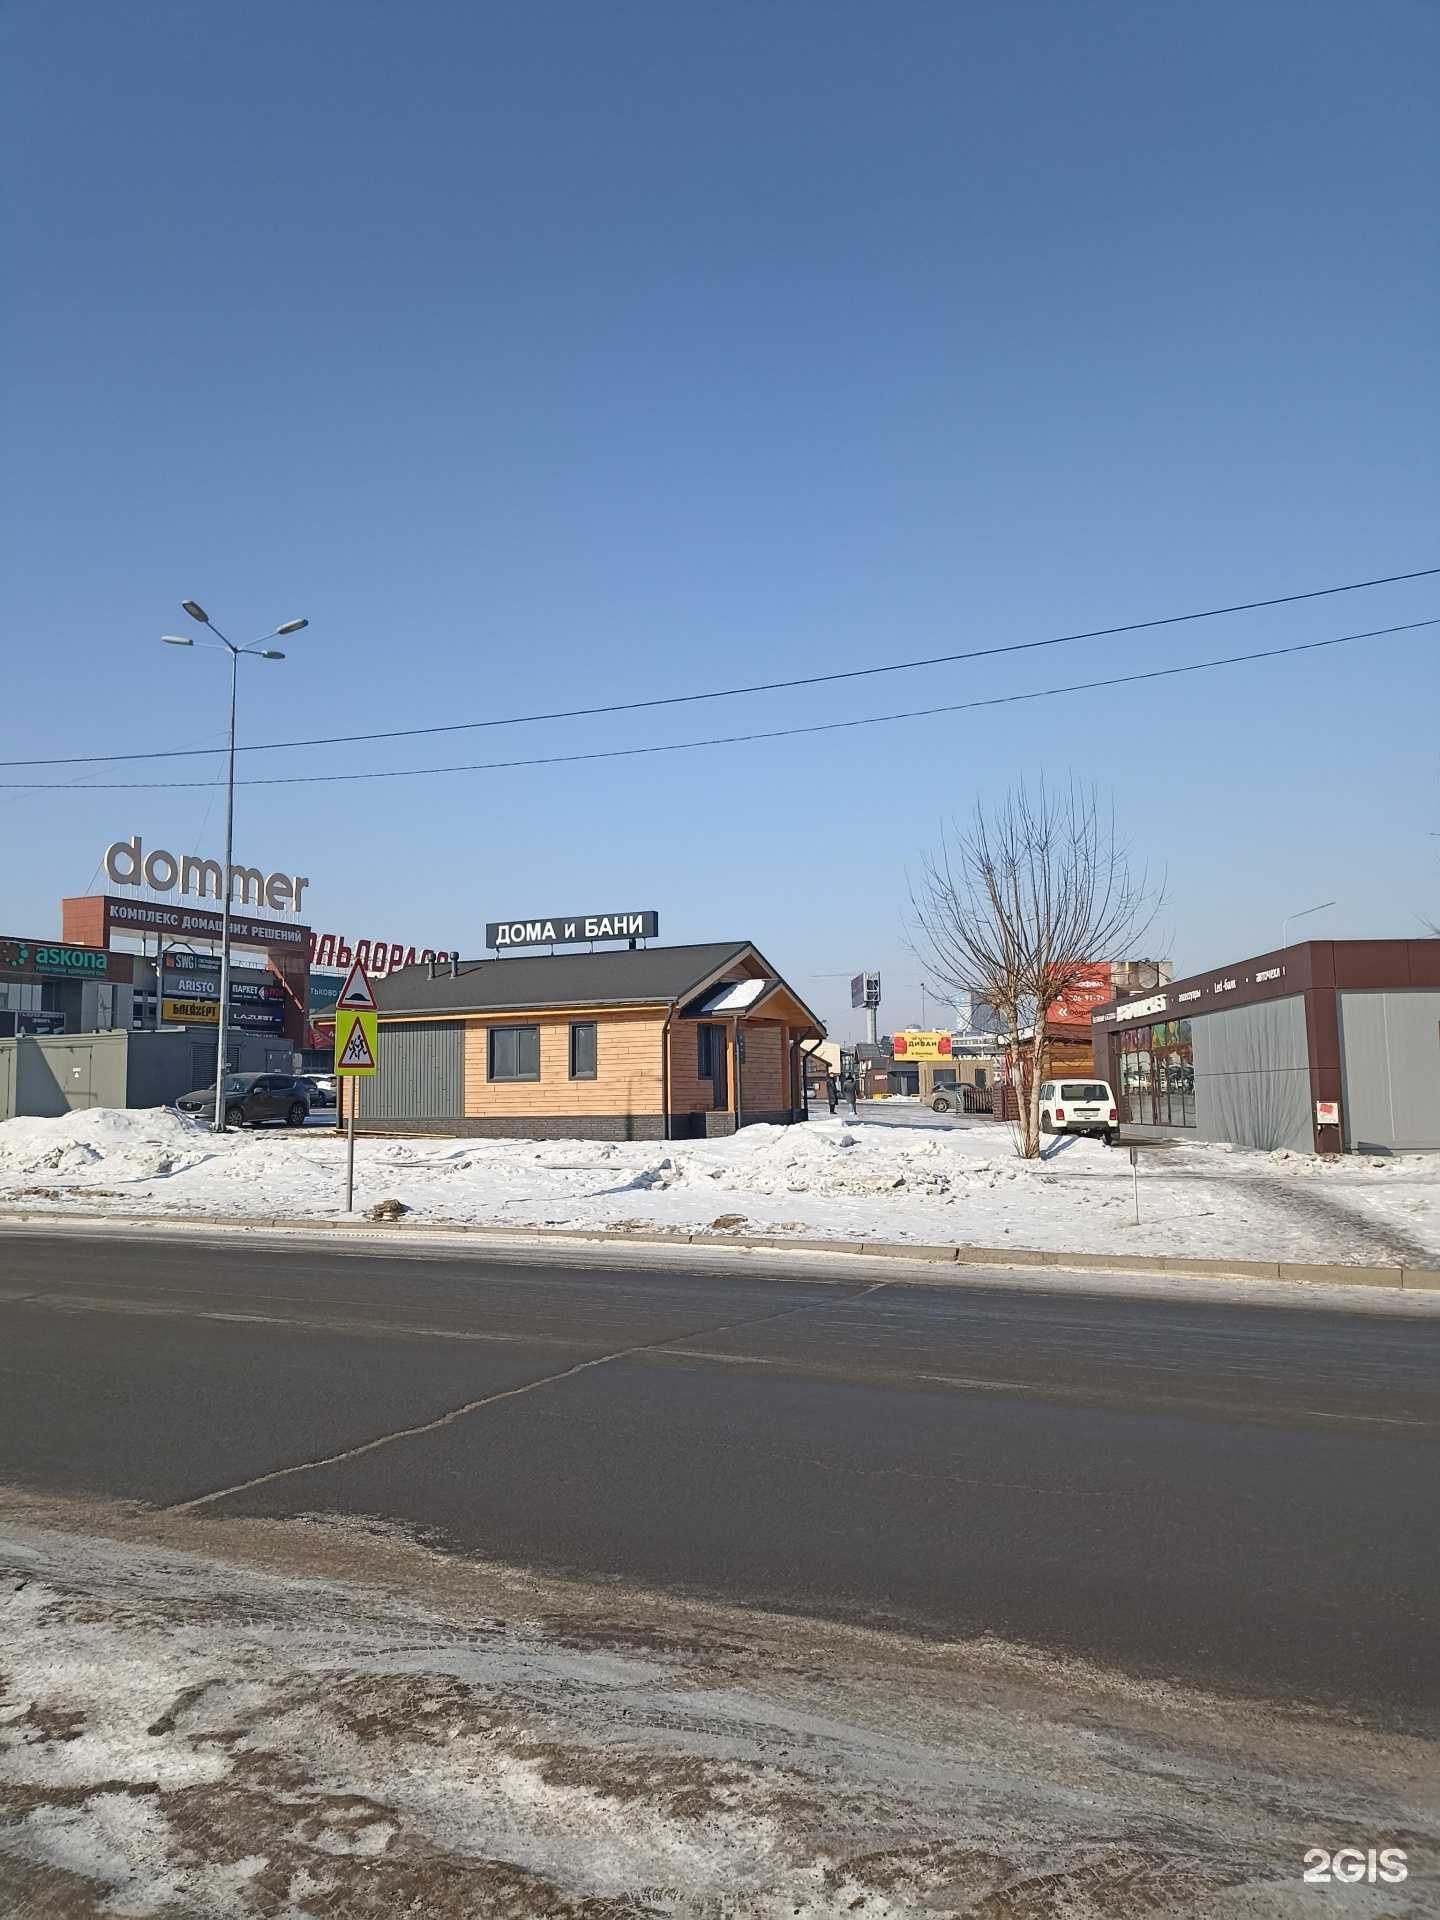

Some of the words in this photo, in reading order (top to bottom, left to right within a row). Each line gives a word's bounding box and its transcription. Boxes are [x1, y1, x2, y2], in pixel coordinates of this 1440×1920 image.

[104, 836, 309, 912] dommer
[110, 905, 178, 925] КОМПЛЕКС
[251, 926, 302, 943] РЕШЕНИЙ
[495, 922, 557, 945] ДОМА
[564, 923, 576, 939] и
[585, 915, 643, 937] БАНИ
[35, 948, 108, 969] askona
[175, 954, 194, 969] SWG
[178, 980, 215, 993] ARISTO
[231, 984, 259, 995] ПАРКЕТ
[908, 1040, 937, 1048] ДИВАН
